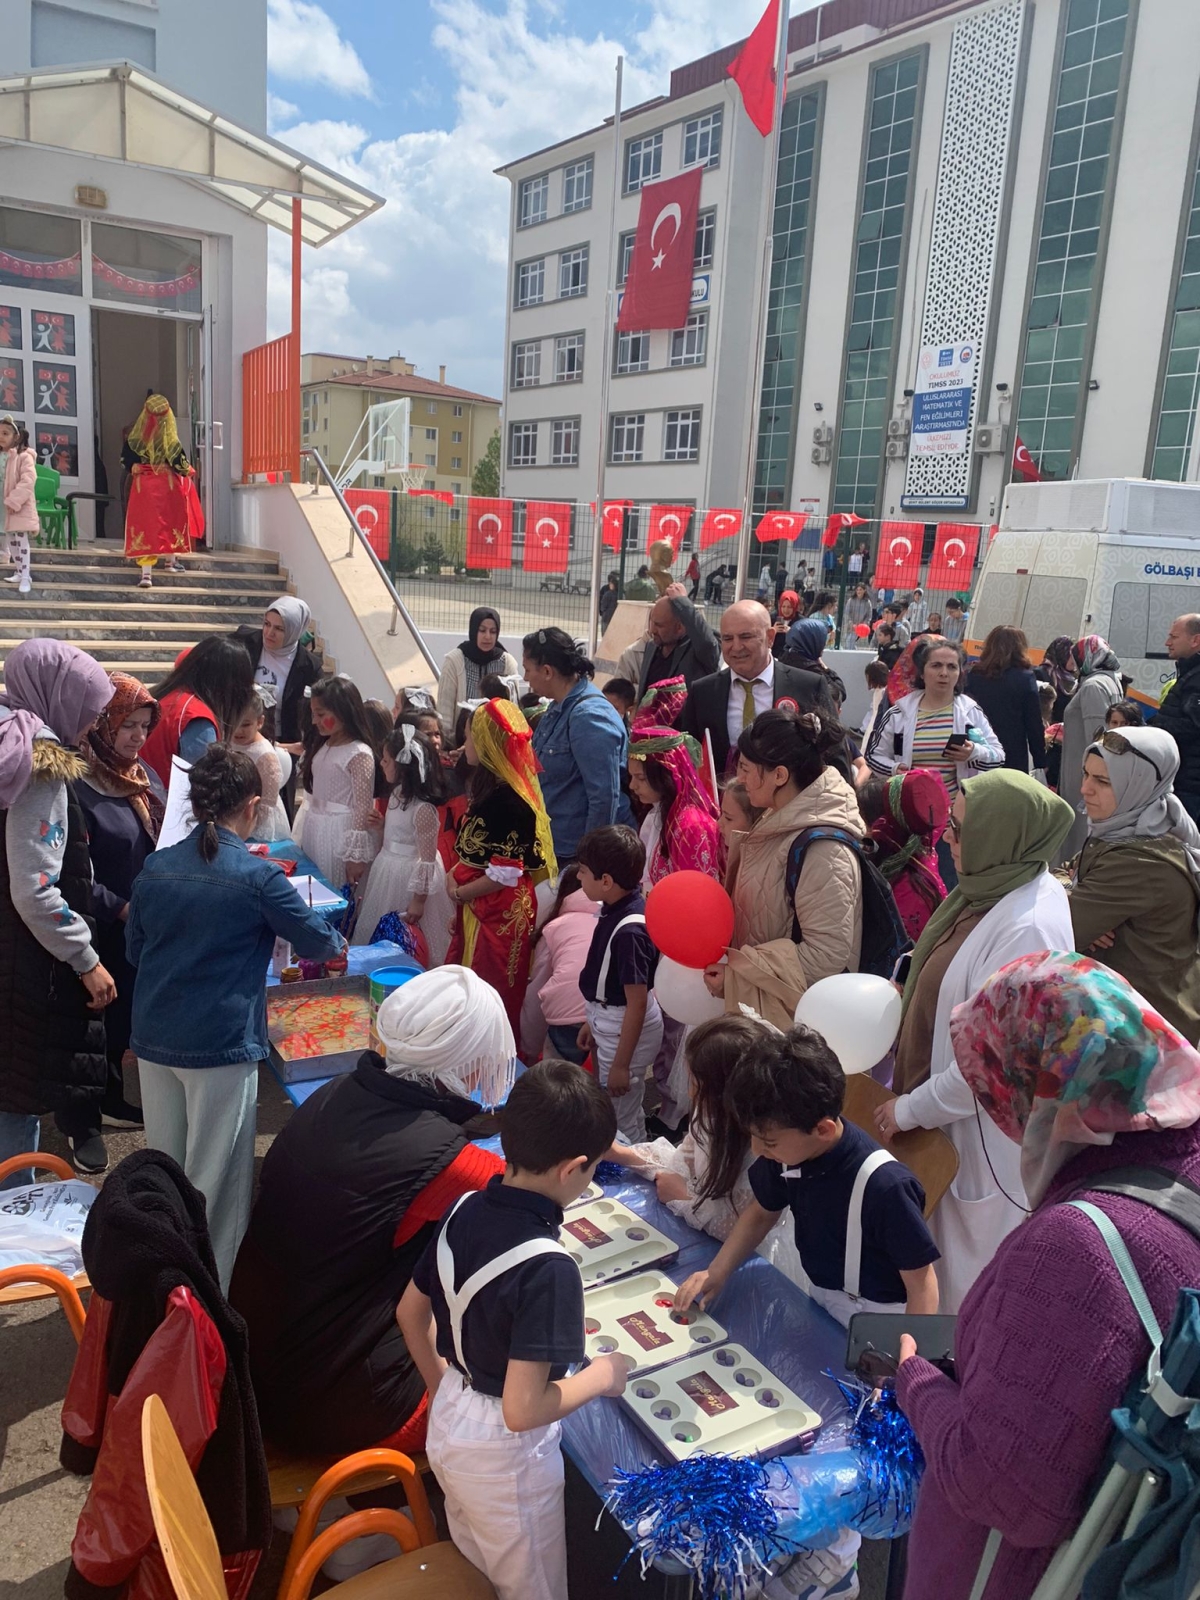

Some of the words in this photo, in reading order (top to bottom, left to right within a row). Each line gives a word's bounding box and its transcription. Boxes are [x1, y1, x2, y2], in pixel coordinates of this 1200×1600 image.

[928, 381, 948, 389] TIMSS
[948, 379, 963, 387] 2023
[922, 390, 963, 401] ULUSLARARASI
[1144, 561, 1194, 580] GÖLBAŞI
[629, 1317, 661, 1345] Mangala
[691, 1378, 725, 1410] Mangala
